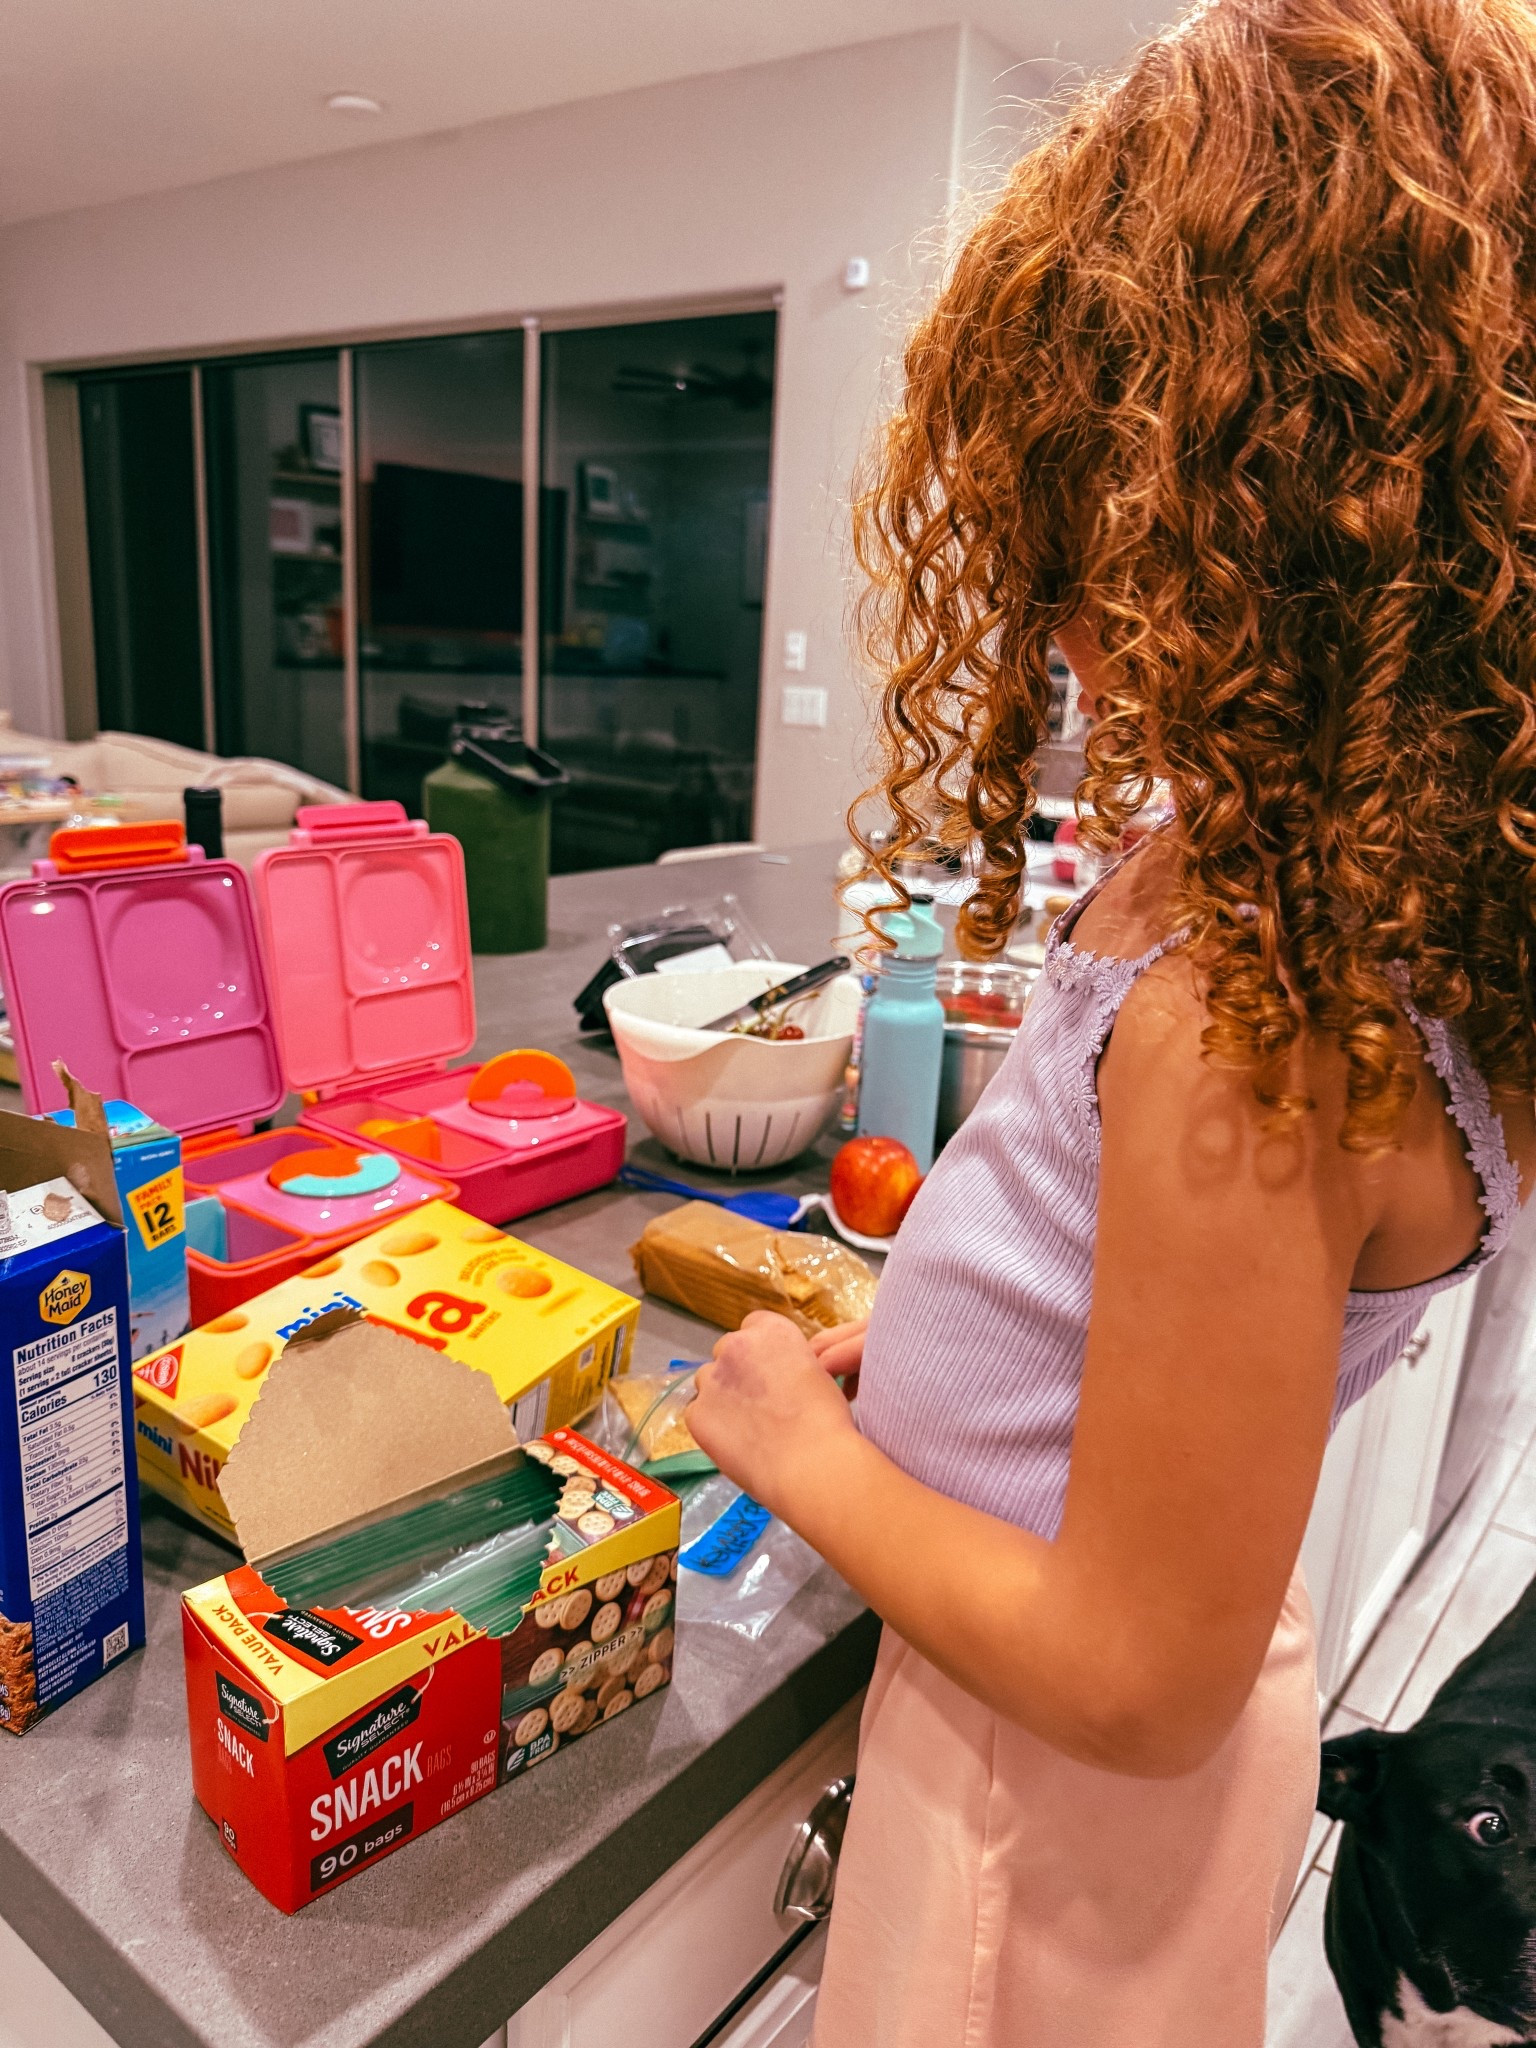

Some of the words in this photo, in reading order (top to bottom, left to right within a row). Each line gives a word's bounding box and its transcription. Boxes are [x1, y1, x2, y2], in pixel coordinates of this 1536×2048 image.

[143, 1202, 175, 1233] 12
[45, 1280, 87, 1307] Honey
[49, 1293, 81, 1318] Maid
[17, 1331, 76, 1364] Nutrition
[81, 1313, 113, 1336] Facts
[18, 1363, 36, 1376] about
[38, 1358, 45, 1366] 14
[73, 1343, 81, 1352] per
[19, 1372, 42, 1386] Serving
[43, 1366, 54, 1375] size
[22, 1396, 66, 1422] Calories
[94, 1365, 116, 1386] 130
[27, 1379, 49, 1392] serving
[138, 1420, 172, 1455] mini
[530, 1565, 580, 1606] ACK
[212, 1604, 246, 1634] PACK
[241, 1631, 284, 1676] VALUE
[282, 1618, 341, 1656] Signature
[580, 1635, 626, 1669] ZIPPER
[221, 1683, 260, 1721] Signature
[217, 1717, 254, 1778] SNACK
[336, 1701, 407, 1760] Signature
[530, 1733, 551, 1750] BPA
[479, 1750, 496, 1769] BAGS
[529, 1741, 550, 1758] FREE
[310, 1740, 424, 1842] SNACK
[427, 1744, 452, 1778] BAGS
[320, 1844, 358, 1879] 90
[364, 1823, 403, 1854] bags
